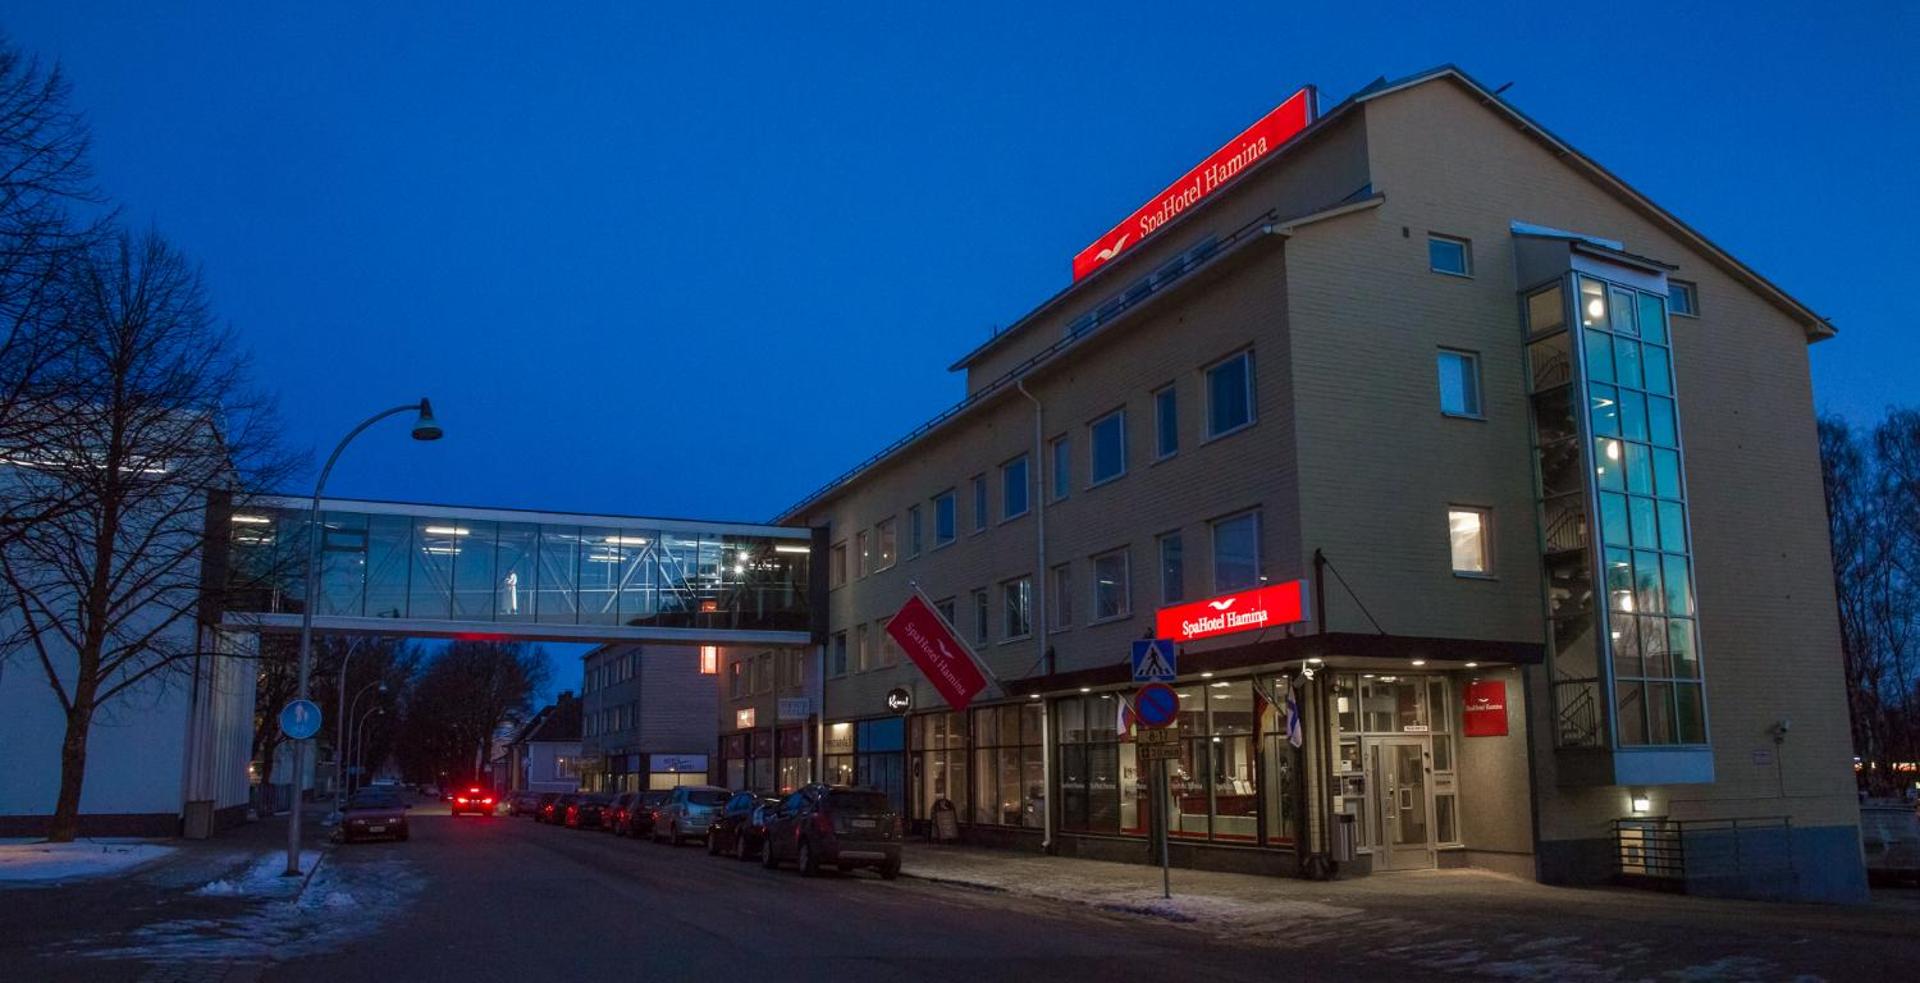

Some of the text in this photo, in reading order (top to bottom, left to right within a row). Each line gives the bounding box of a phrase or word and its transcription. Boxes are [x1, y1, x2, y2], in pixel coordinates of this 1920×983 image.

[1139, 136, 1268, 238] SpaHotel Hamina
[904, 622, 967, 696] SpaHotel Hamina
[1182, 607, 1268, 638] SpaHotel Hamina
